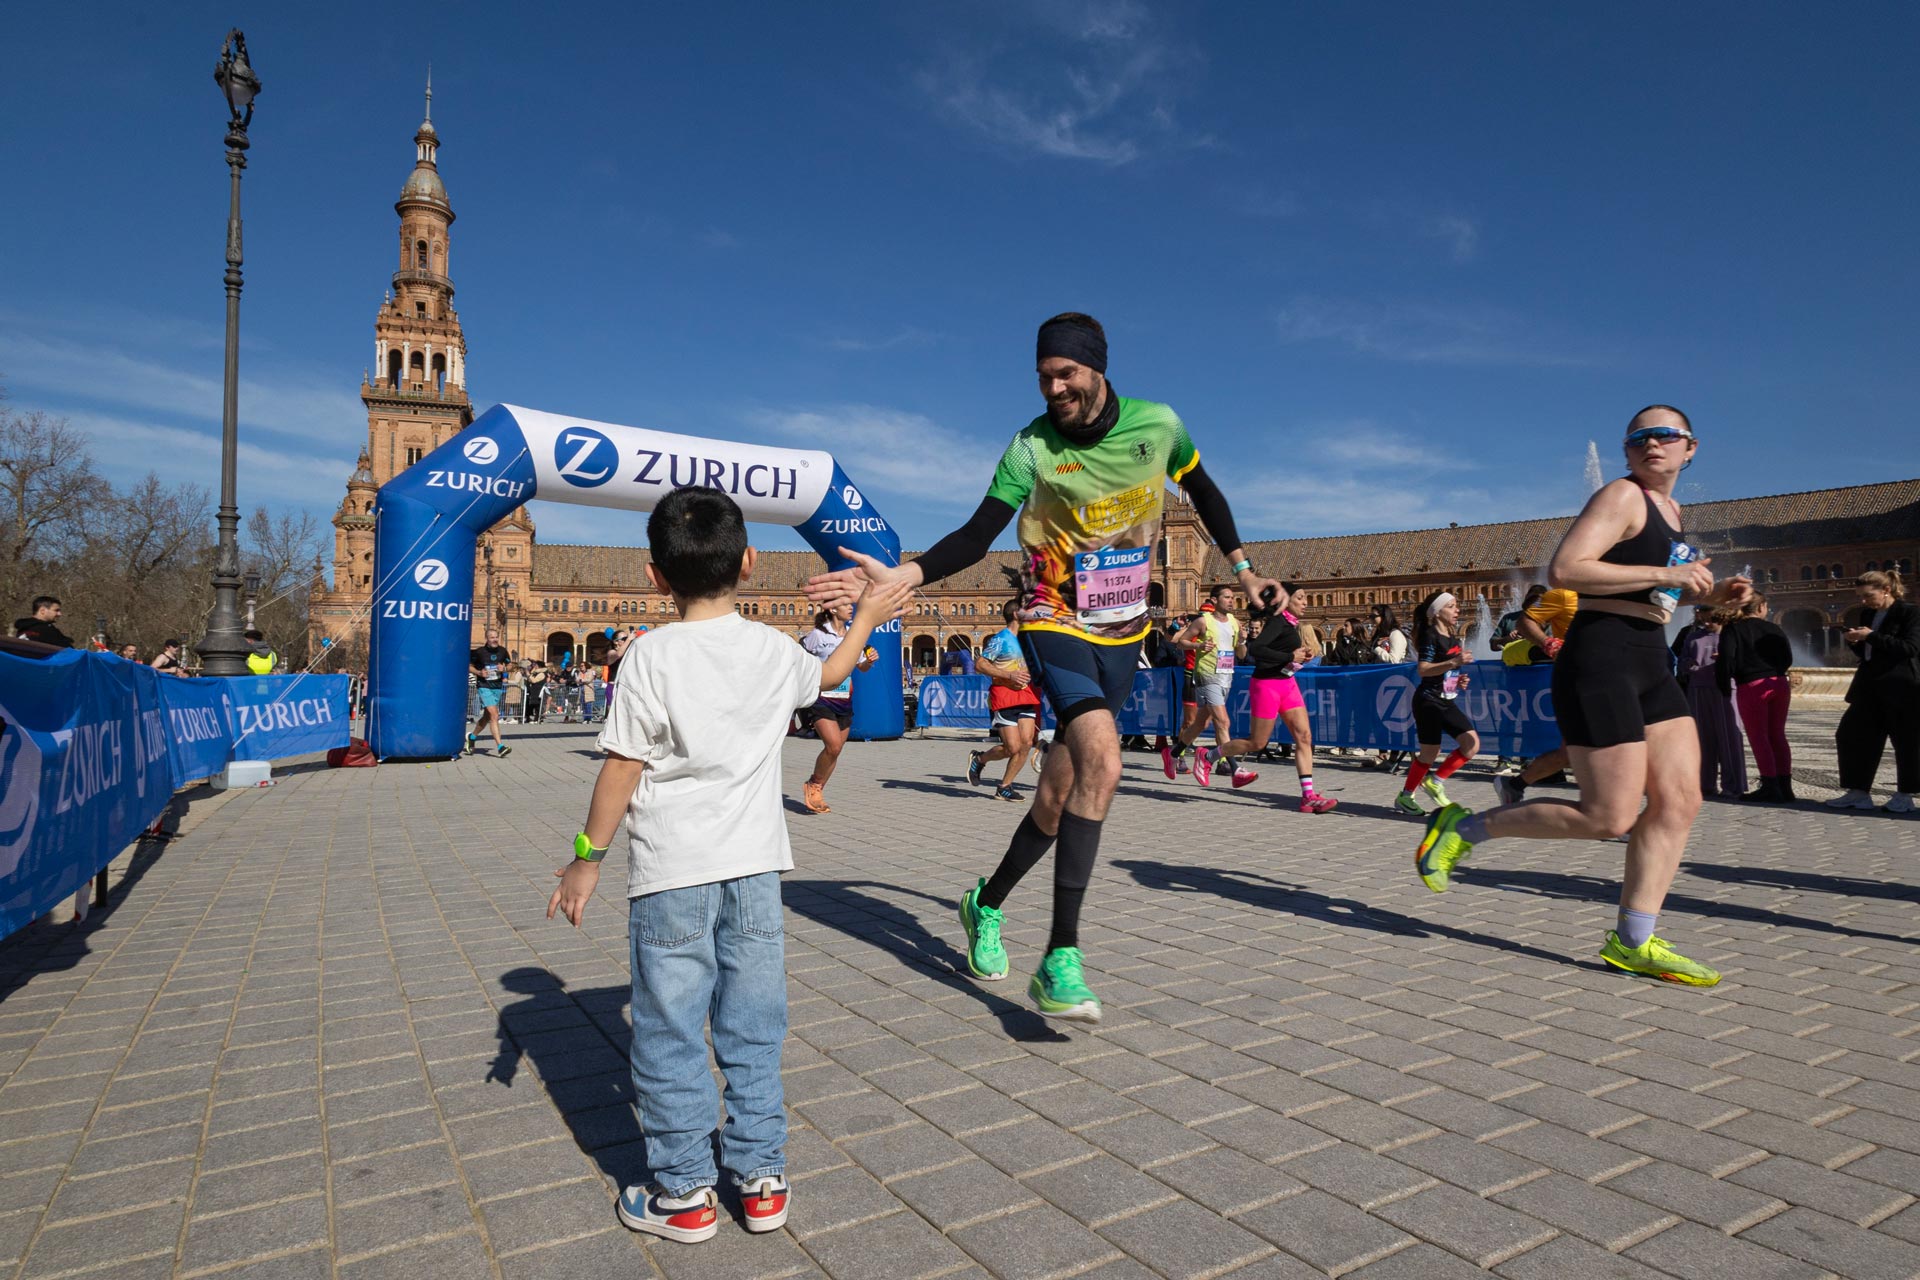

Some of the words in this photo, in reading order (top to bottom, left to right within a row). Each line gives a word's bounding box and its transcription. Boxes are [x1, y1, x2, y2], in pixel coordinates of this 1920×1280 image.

[426, 470, 525, 498] ZURICH
[633, 449, 797, 500] ZURICH
[820, 517, 887, 534] ZURICH
[1103, 551, 1145, 566] ZURICH
[1104, 575, 1132, 587] 11374
[1088, 586, 1144, 608] ENRIQUE
[383, 600, 470, 621] ZURICH
[954, 690, 990, 709] ZUR
[1464, 688, 1557, 721] URIC
[236, 698, 333, 734] ZURICH
[51, 719, 122, 815] ZURICH
[700, 1208, 715, 1223] NIKE
[756, 1199, 775, 1211] NIKE
